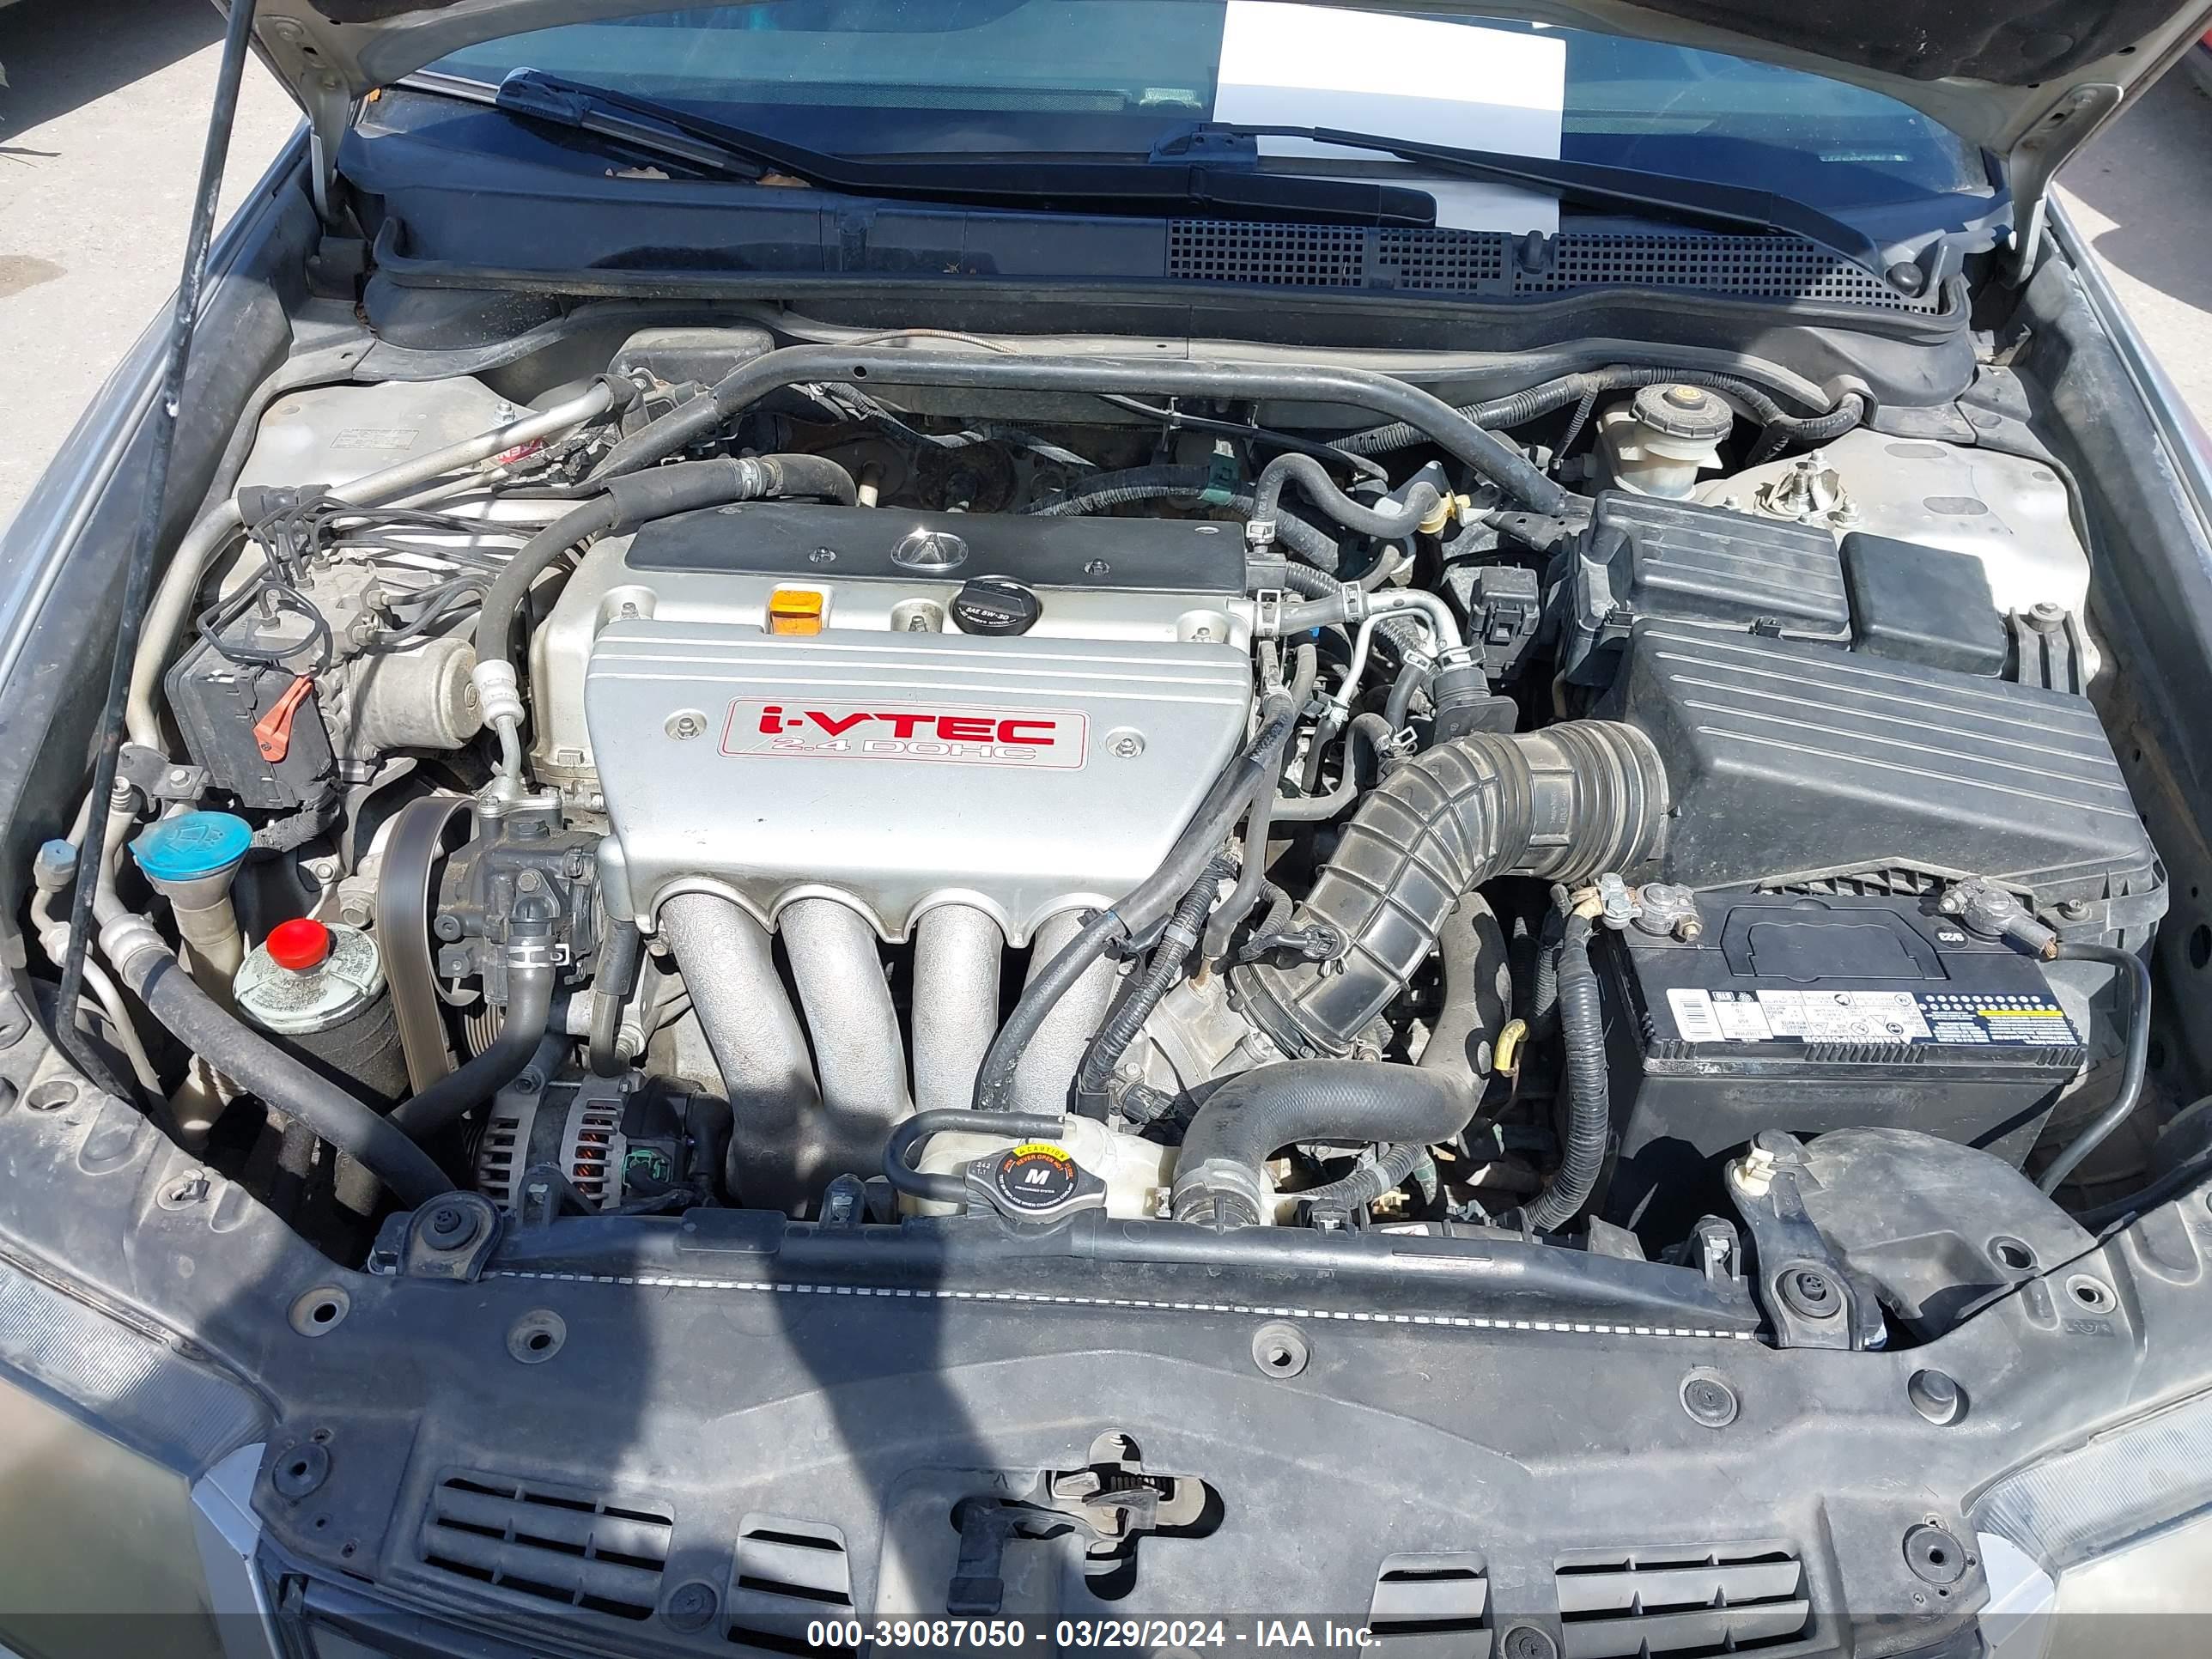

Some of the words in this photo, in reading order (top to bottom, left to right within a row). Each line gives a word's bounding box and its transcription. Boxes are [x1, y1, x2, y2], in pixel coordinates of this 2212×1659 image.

[981, 610, 1010, 620] 5W-30
[758, 706, 1056, 745] i-VTEC
[773, 737, 852, 752] 2.4
[862, 740, 1037, 759] DOHC
[1027, 1146, 1066, 1159] CAUTION
